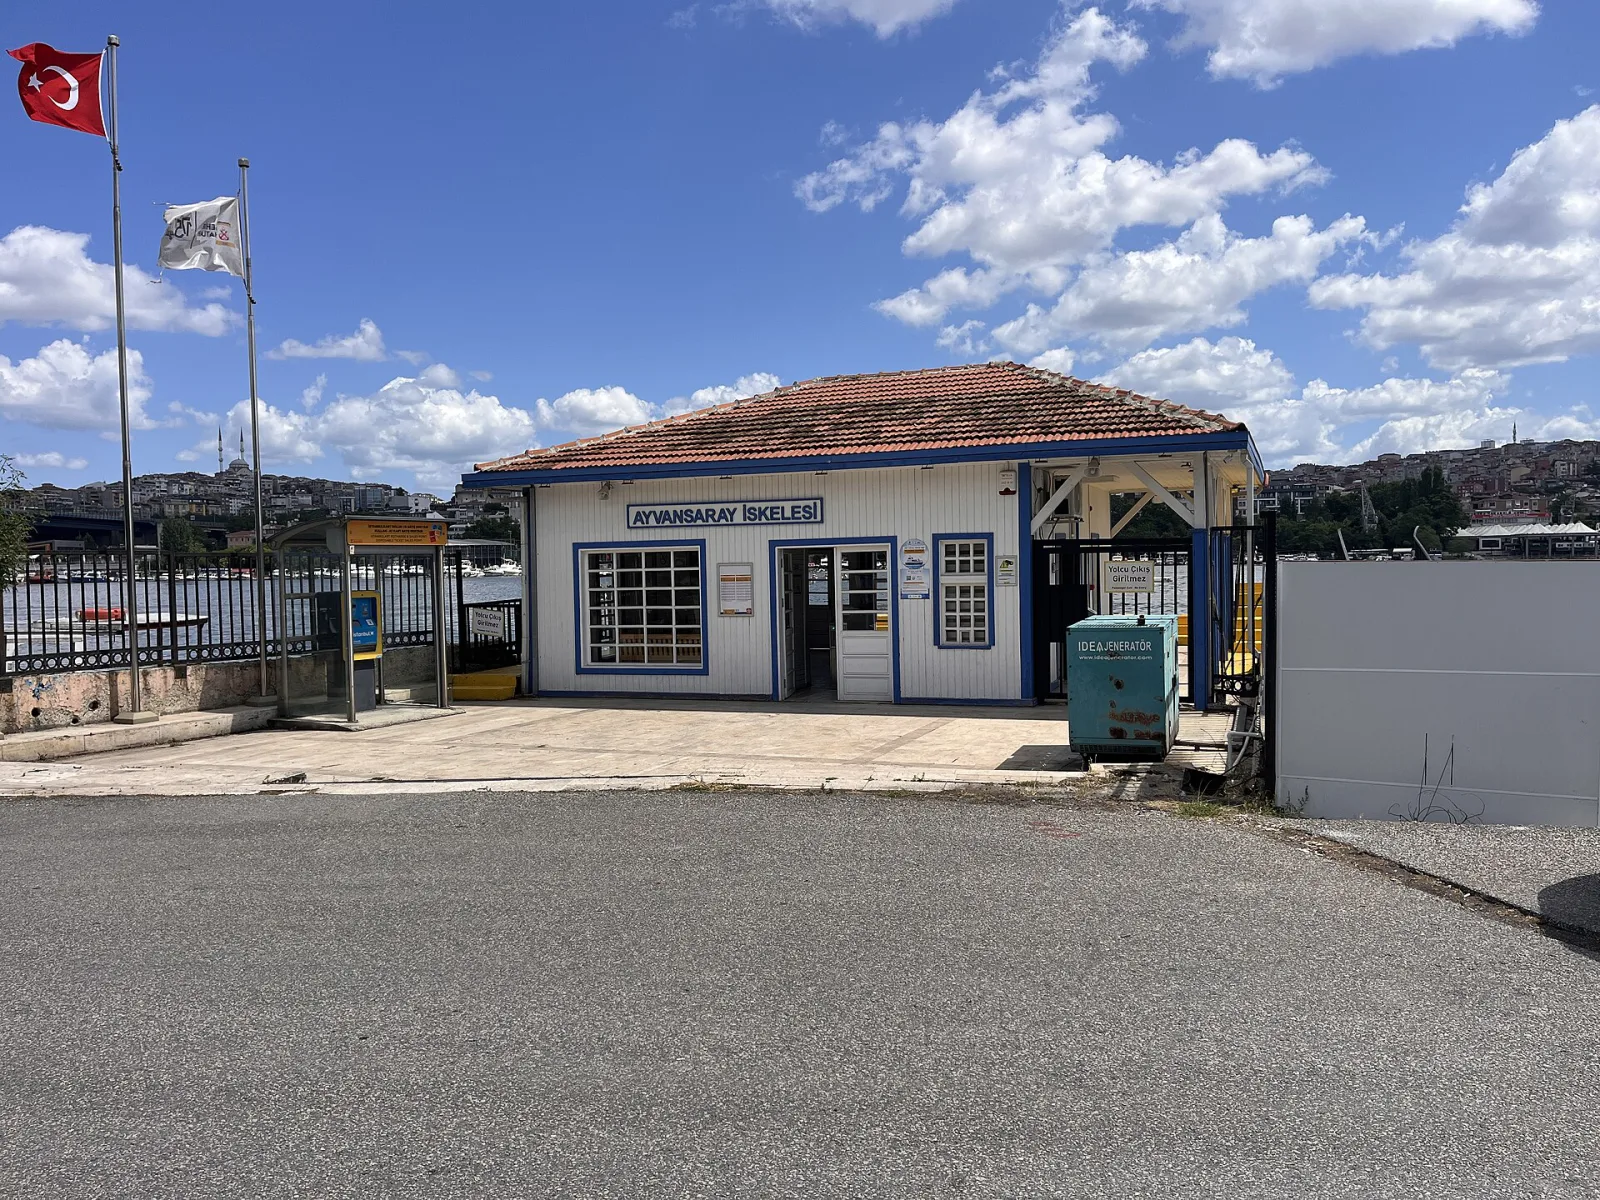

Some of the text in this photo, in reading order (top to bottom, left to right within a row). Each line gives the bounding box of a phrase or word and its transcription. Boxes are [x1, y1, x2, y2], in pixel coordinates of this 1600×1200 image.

[633, 501, 818, 525] AYVANSARAY İSKELESİ
[1131, 565, 1150, 574] Çıkış
